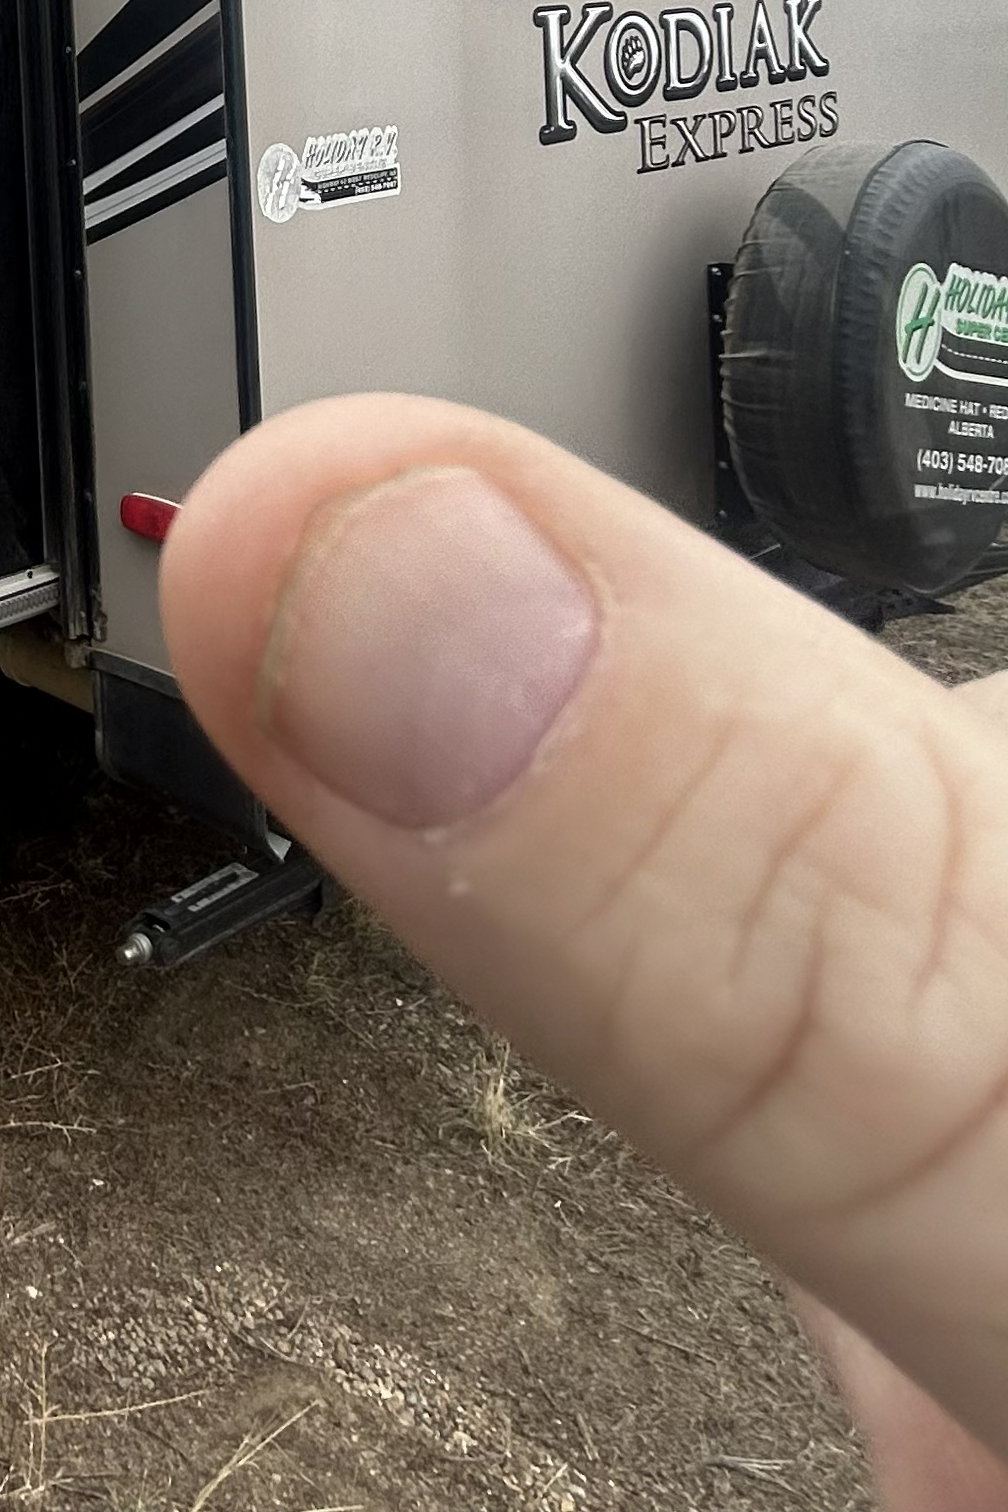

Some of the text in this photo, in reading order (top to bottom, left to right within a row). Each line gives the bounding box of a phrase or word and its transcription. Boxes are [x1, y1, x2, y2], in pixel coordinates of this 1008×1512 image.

[635, 91, 839, 174] EXPRESS
[943, 273, 1008, 322] HOLIDA
[904, 392, 958, 414] MEDICINE
[959, 400, 981, 416] HAT
[948, 420, 994, 439] ALBERTA
[917, 448, 954, 474] (403)
